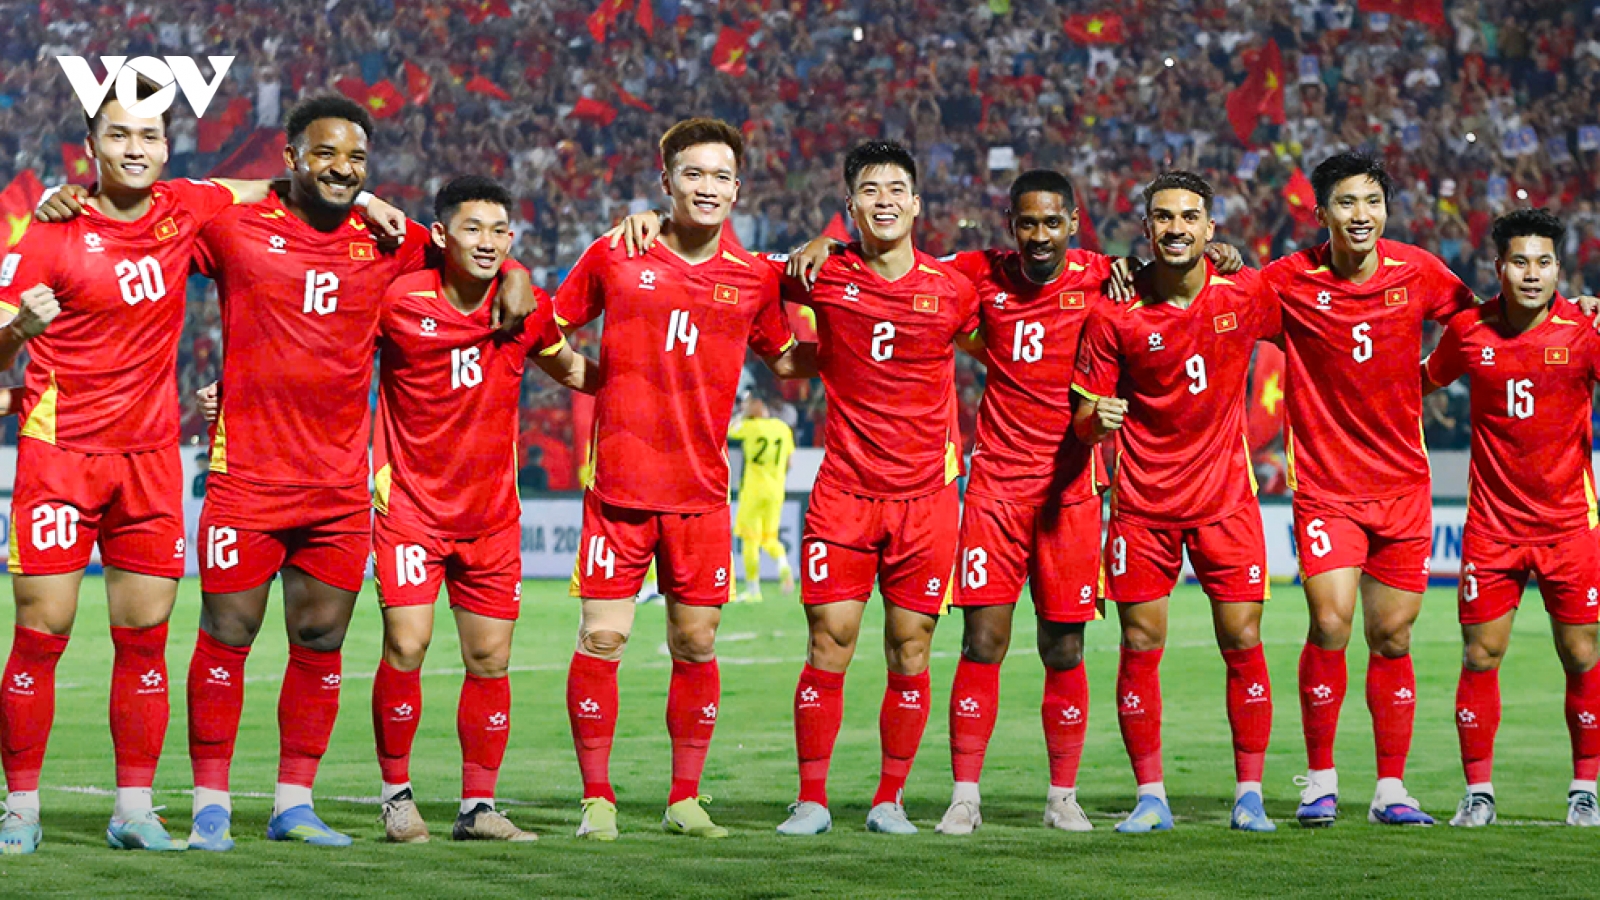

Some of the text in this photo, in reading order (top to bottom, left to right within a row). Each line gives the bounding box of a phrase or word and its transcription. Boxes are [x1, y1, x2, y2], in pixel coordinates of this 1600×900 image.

[113, 254, 165, 307] 20
[302, 269, 340, 316] 12
[664, 308, 699, 357] 14
[871, 321, 896, 362] 2
[1012, 319, 1046, 363] 13
[1351, 321, 1373, 364] 5
[450, 345, 483, 391] 18
[1185, 353, 1208, 396] 9
[1506, 378, 1535, 420] 15
[753, 437, 781, 466] 21
[31, 503, 80, 551] 20
[206, 525, 239, 570] 12
[1306, 518, 1333, 558] 5
[395, 543, 428, 587] 18
[586, 534, 616, 580] 14
[808, 541, 829, 583] 2
[961, 546, 988, 590] 13
[1111, 535, 1127, 577] 9
